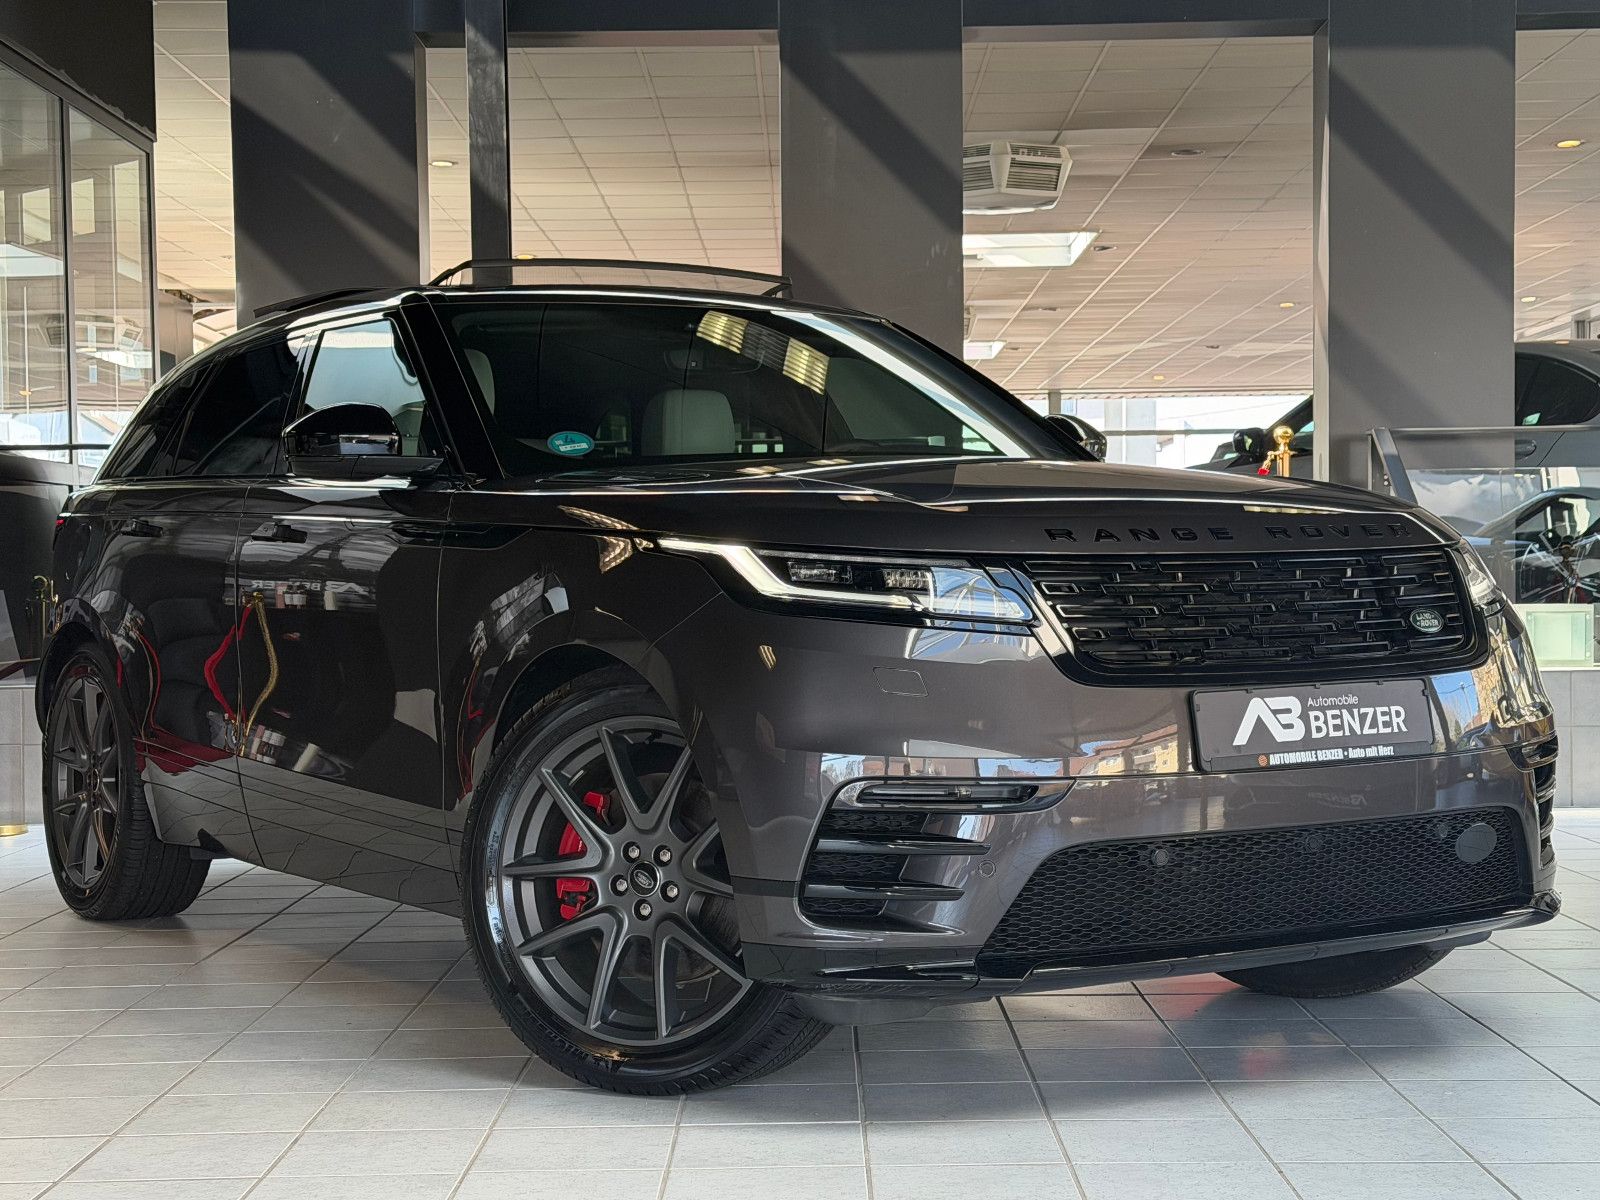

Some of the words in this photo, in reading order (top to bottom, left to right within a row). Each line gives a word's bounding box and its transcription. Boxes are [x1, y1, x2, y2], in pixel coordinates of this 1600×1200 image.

[1044, 527, 1234, 543] RANGE
[1264, 524, 1412, 539] ROVER
[1307, 694, 1359, 707] Automobile
[1232, 696, 1305, 746] AB
[1308, 705, 1409, 739] BENZER
[1269, 750, 1317, 766] AUTOMOBILE
[1316, 748, 1345, 761] BENZER
[1348, 747, 1366, 759] Auto
[1365, 745, 1379, 757] mit
[1378, 744, 1395, 756] Herz
